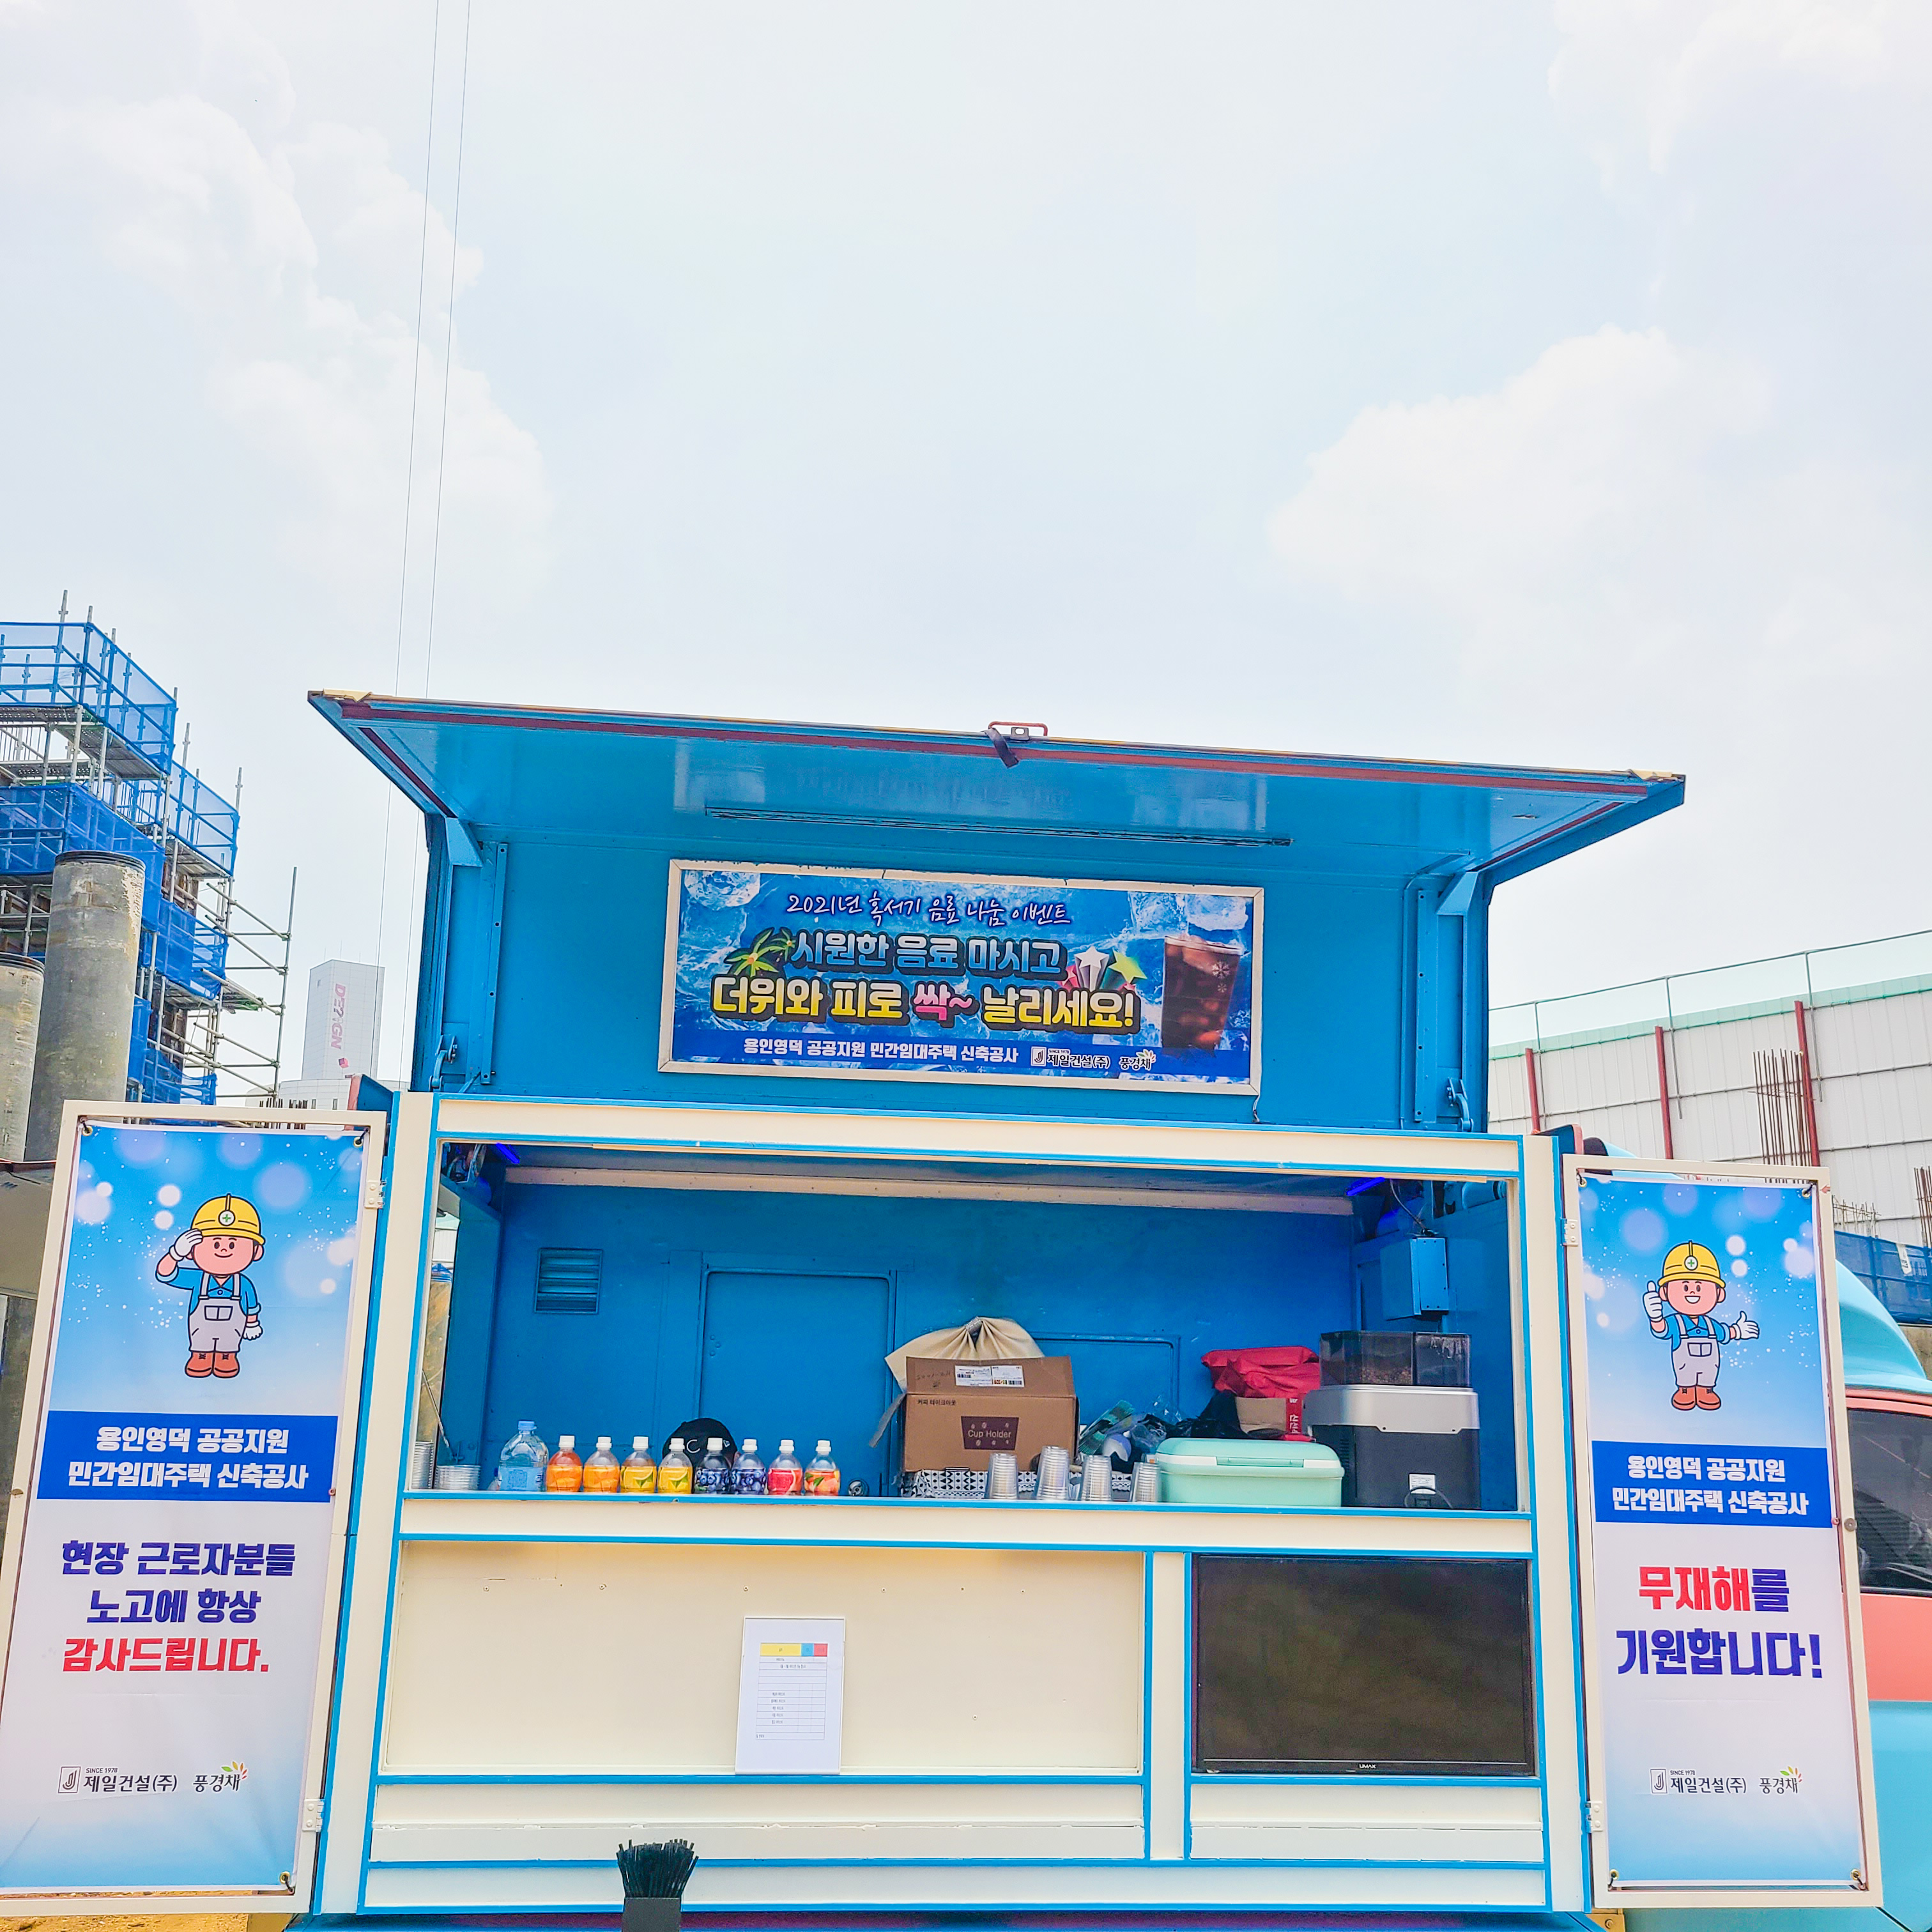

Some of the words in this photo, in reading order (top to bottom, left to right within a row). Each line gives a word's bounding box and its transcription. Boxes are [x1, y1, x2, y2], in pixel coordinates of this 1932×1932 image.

[786, 894, 862, 914] 2021년
[869, 891, 921, 926] 혹서기
[928, 895, 960, 922] 음료
[967, 900, 1005, 927] 나눔
[1011, 903, 1071, 926] 이벤트
[792, 931, 889, 966] 시원한
[896, 937, 958, 970] 음료
[966, 940, 1061, 974] 마시고
[712, 976, 824, 1016] 더위와
[831, 981, 903, 1018] 피로
[912, 983, 972, 1021] 싹~
[983, 986, 1135, 1028] 날리세요!
[744, 1038, 803, 1055] 용인영덕
[807, 1040, 866, 1058] 공공지원
[870, 1042, 957, 1061] 민간임대주택
[960, 1046, 1020, 1063] 신축공사
[1048, 1054, 1110, 1068] 제일건설(주)
[1120, 1057, 1151, 1070] 풍경채
[96, 1427, 190, 1452] 용인영덕
[197, 1429, 289, 1454] 공공지원
[967, 1429, 984, 1438] Cup
[986, 1430, 1012, 1438] Holder
[68, 1460, 212, 1487] 민간임대주택
[217, 1464, 309, 1489] 신축공사
[1628, 1455, 1701, 1480] 용인영덕
[1706, 1457, 1786, 1483] 공공지원
[1612, 1487, 1723, 1514] 민간임대주택
[1728, 1491, 1809, 1515] 신축공사
[62, 1540, 129, 1575] 현장
[137, 1542, 296, 1577] 근로자분들
[1638, 1565, 1790, 1613] 무재해를
[87, 1590, 188, 1623] 노고에
[197, 1588, 261, 1623] 항상
[63, 1638, 269, 1673] 감사드립니다.
[1616, 1628, 1822, 1678] 기원합니다!
[83, 1775, 178, 1793] 제일건설(주)
[193, 1774, 241, 1792] 풍경채
[1670, 1777, 1747, 1793] 제일건설(주)
[1759, 1777, 1798, 1794] 풍경채
